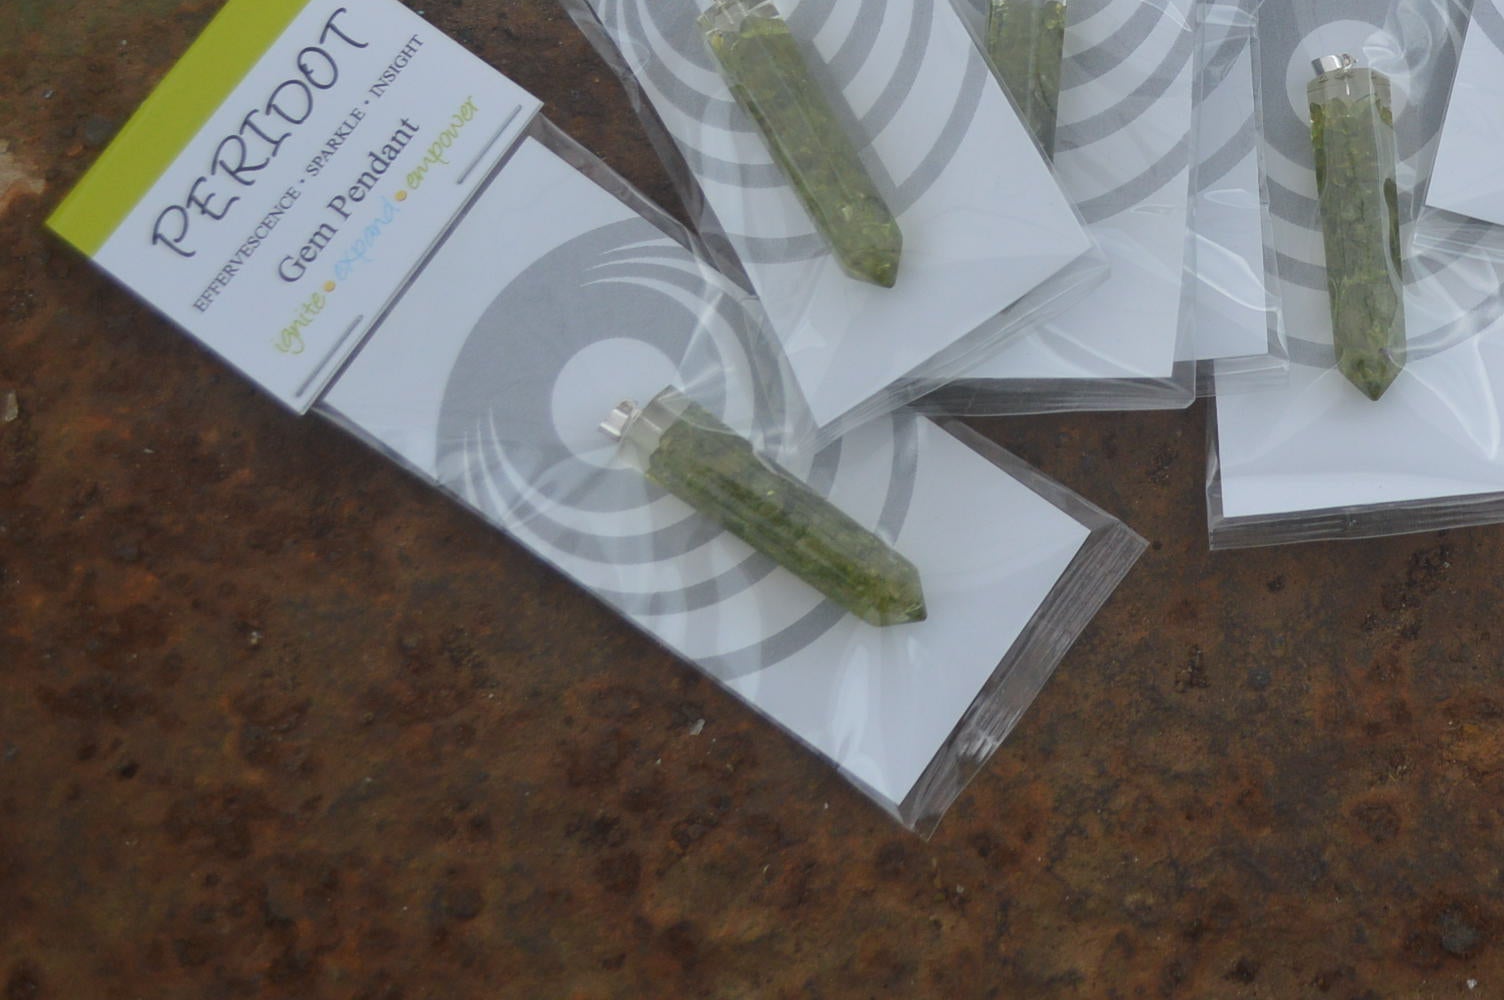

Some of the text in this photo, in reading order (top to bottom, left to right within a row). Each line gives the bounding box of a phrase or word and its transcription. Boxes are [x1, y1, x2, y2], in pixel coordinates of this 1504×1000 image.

[151, 7, 369, 257] PERIDOT
[193, 33, 424, 313] EFFERVESCENCE SPARKLE INSIGHT
[273, 94, 480, 356] ignite expand empower
[277, 118, 421, 283] Gem Pendant
